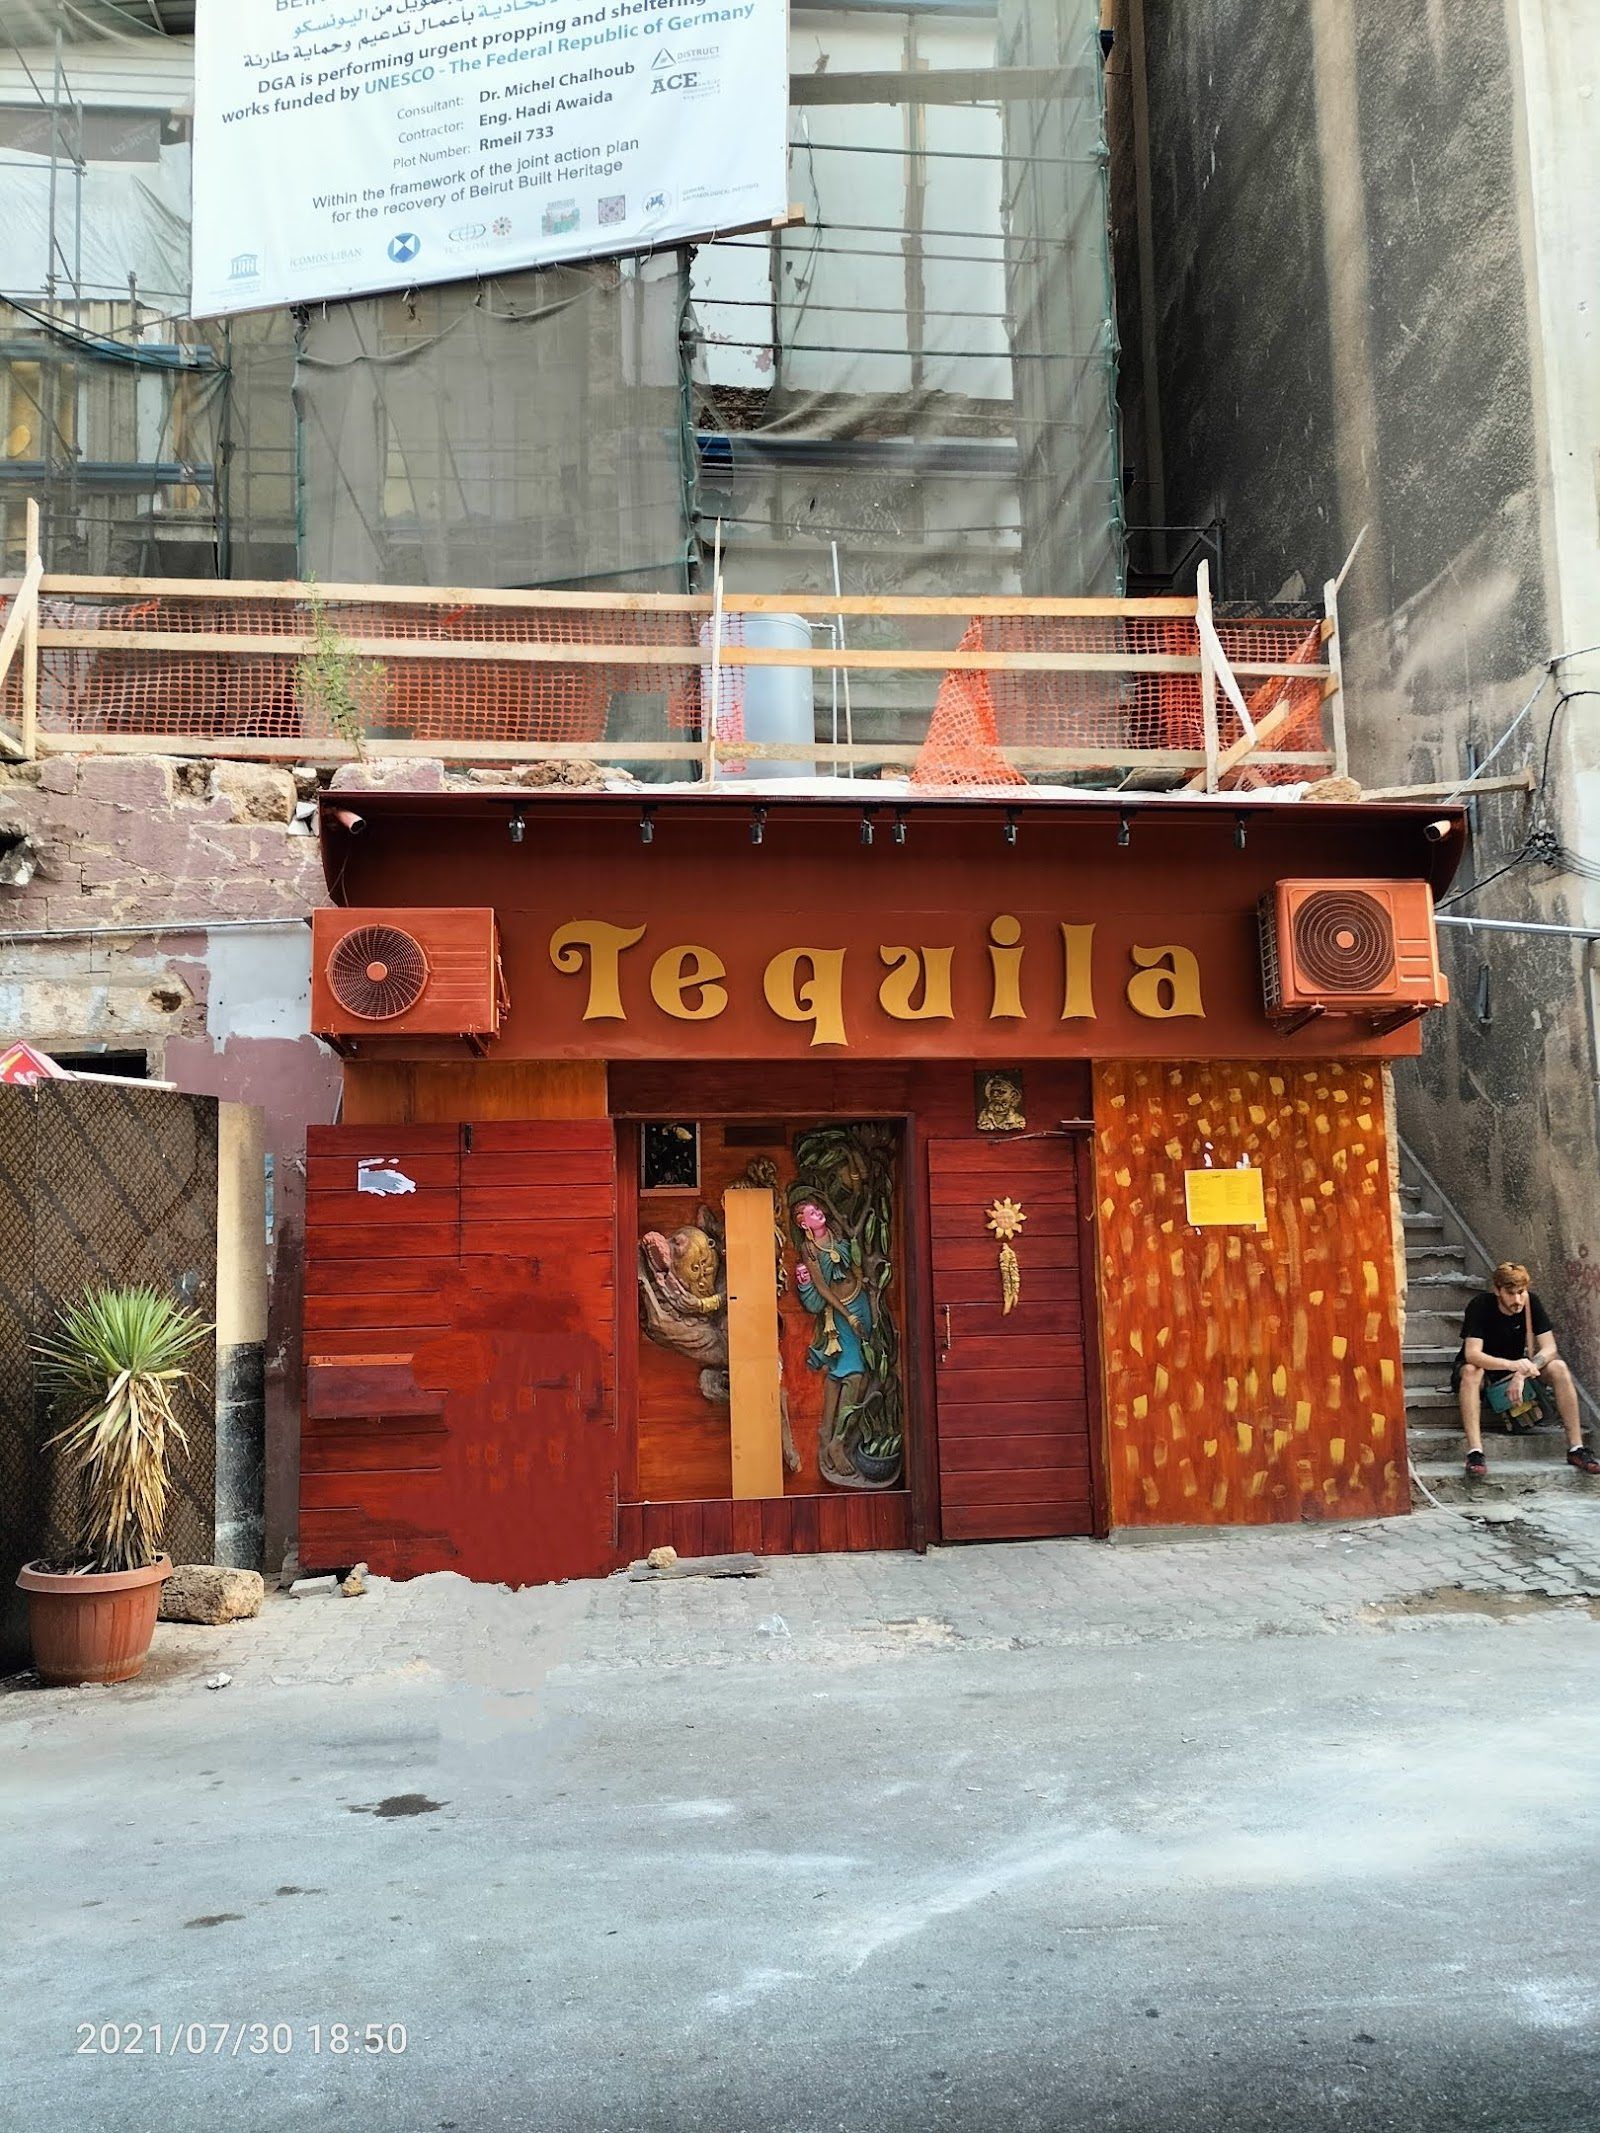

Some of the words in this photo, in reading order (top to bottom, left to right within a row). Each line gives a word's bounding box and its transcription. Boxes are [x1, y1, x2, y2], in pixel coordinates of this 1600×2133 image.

[292, 7, 368, 40] اليونسكو
[358, 20, 411, 51] تدعيم
[371, 3, 393, 21] من
[414, 8, 475, 35] بأعمال
[222, 102, 270, 124] works
[274, 88, 335, 112] funded
[340, 85, 360, 101] by
[364, 66, 435, 94] UNESCO
[449, 57, 481, 75] The
[486, 40, 553, 68] Federal
[558, 24, 638, 52] Republic
[643, 18, 663, 35] of
[668, 4, 755, 31] Germany
[258, 75, 296, 94] DGA
[300, 72, 313, 86] is
[318, 51, 414, 86] performing
[419, 36, 477, 59] urgent
[482, 18, 566, 49] propping
[571, 7, 606, 27] and
[293, 40, 351, 61] وحماية
[397, 96, 464, 120] Consultant:
[479, 90, 501, 104] Dr.
[504, 76, 555, 98] Michel
[558, 62, 635, 87] Chalhoub
[650, 72, 697, 95] ACE
[398, 121, 464, 143] Contractor:
[479, 111, 512, 127] Eng.
[516, 99, 551, 119] Hadi
[555, 91, 614, 112] Awaida
[393, 155, 417, 169] Plot
[419, 144, 471, 165] Number:
[479, 131, 522, 151] Rmeil
[526, 125, 554, 141] 733
[312, 192, 358, 210] Within
[363, 184, 385, 201] the
[390, 168, 466, 196] framework
[470, 164, 485, 181] of
[490, 160, 512, 177] the
[516, 154, 550, 174] joint
[554, 145, 600, 164] action
[606, 138, 640, 158] plan
[332, 210, 351, 224] for
[356, 207, 378, 220] the
[384, 191, 447, 215] recovery
[451, 186, 465, 202] of
[469, 178, 513, 198] Beirut
[518, 170, 552, 189] Built
[557, 159, 623, 182] Heritage
[548, 914, 1206, 1047] Tequila
